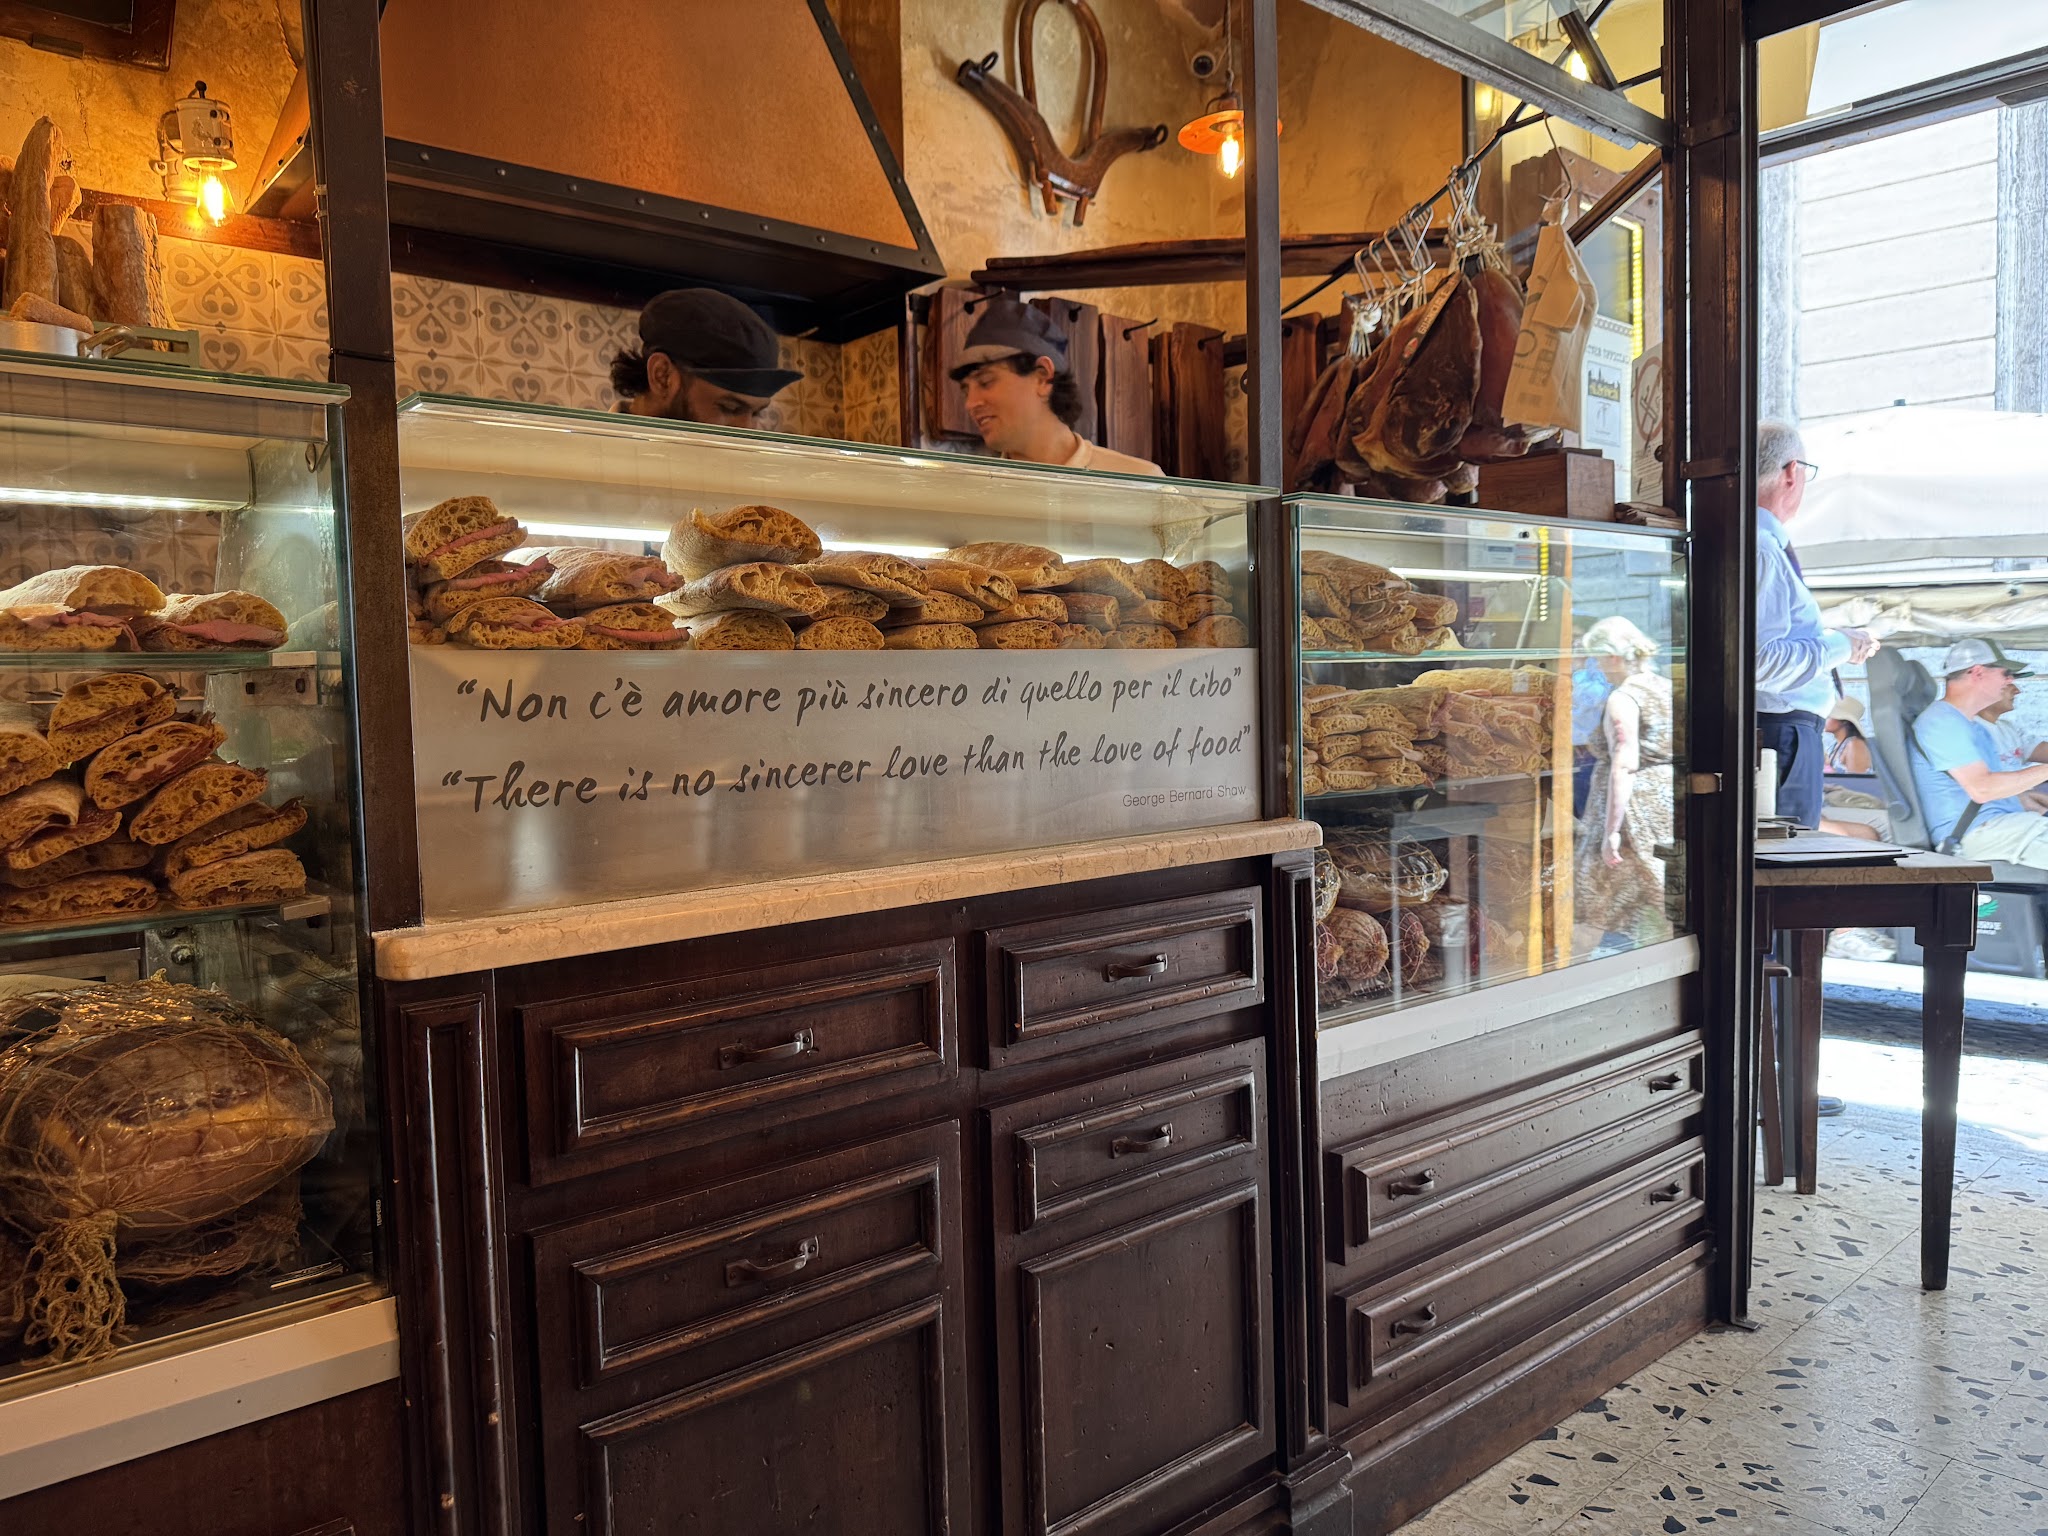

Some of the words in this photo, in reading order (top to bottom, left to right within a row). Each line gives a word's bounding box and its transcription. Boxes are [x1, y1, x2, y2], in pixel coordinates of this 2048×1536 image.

[663, 686, 782, 719] amore
[797, 678, 848, 726] più
[857, 679, 968, 709] sincero
[982, 676, 1011, 705] di
[1020, 670, 1102, 721] quello
[1112, 678, 1153, 713] per
[1162, 668, 1182, 698] il
[618, 766, 654, 801] is
[672, 768, 715, 797] no
[728, 757, 872, 793] sincerer
[882, 745, 948, 780] love
[963, 734, 1025, 776] than
[1039, 730, 1081, 771] the
[1090, 733, 1142, 765] love
[1153, 727, 1182, 767] of
[1122, 793, 1165, 808] George
[1169, 786, 1213, 803] Bernard
[1217, 784, 1247, 798] Shaw
